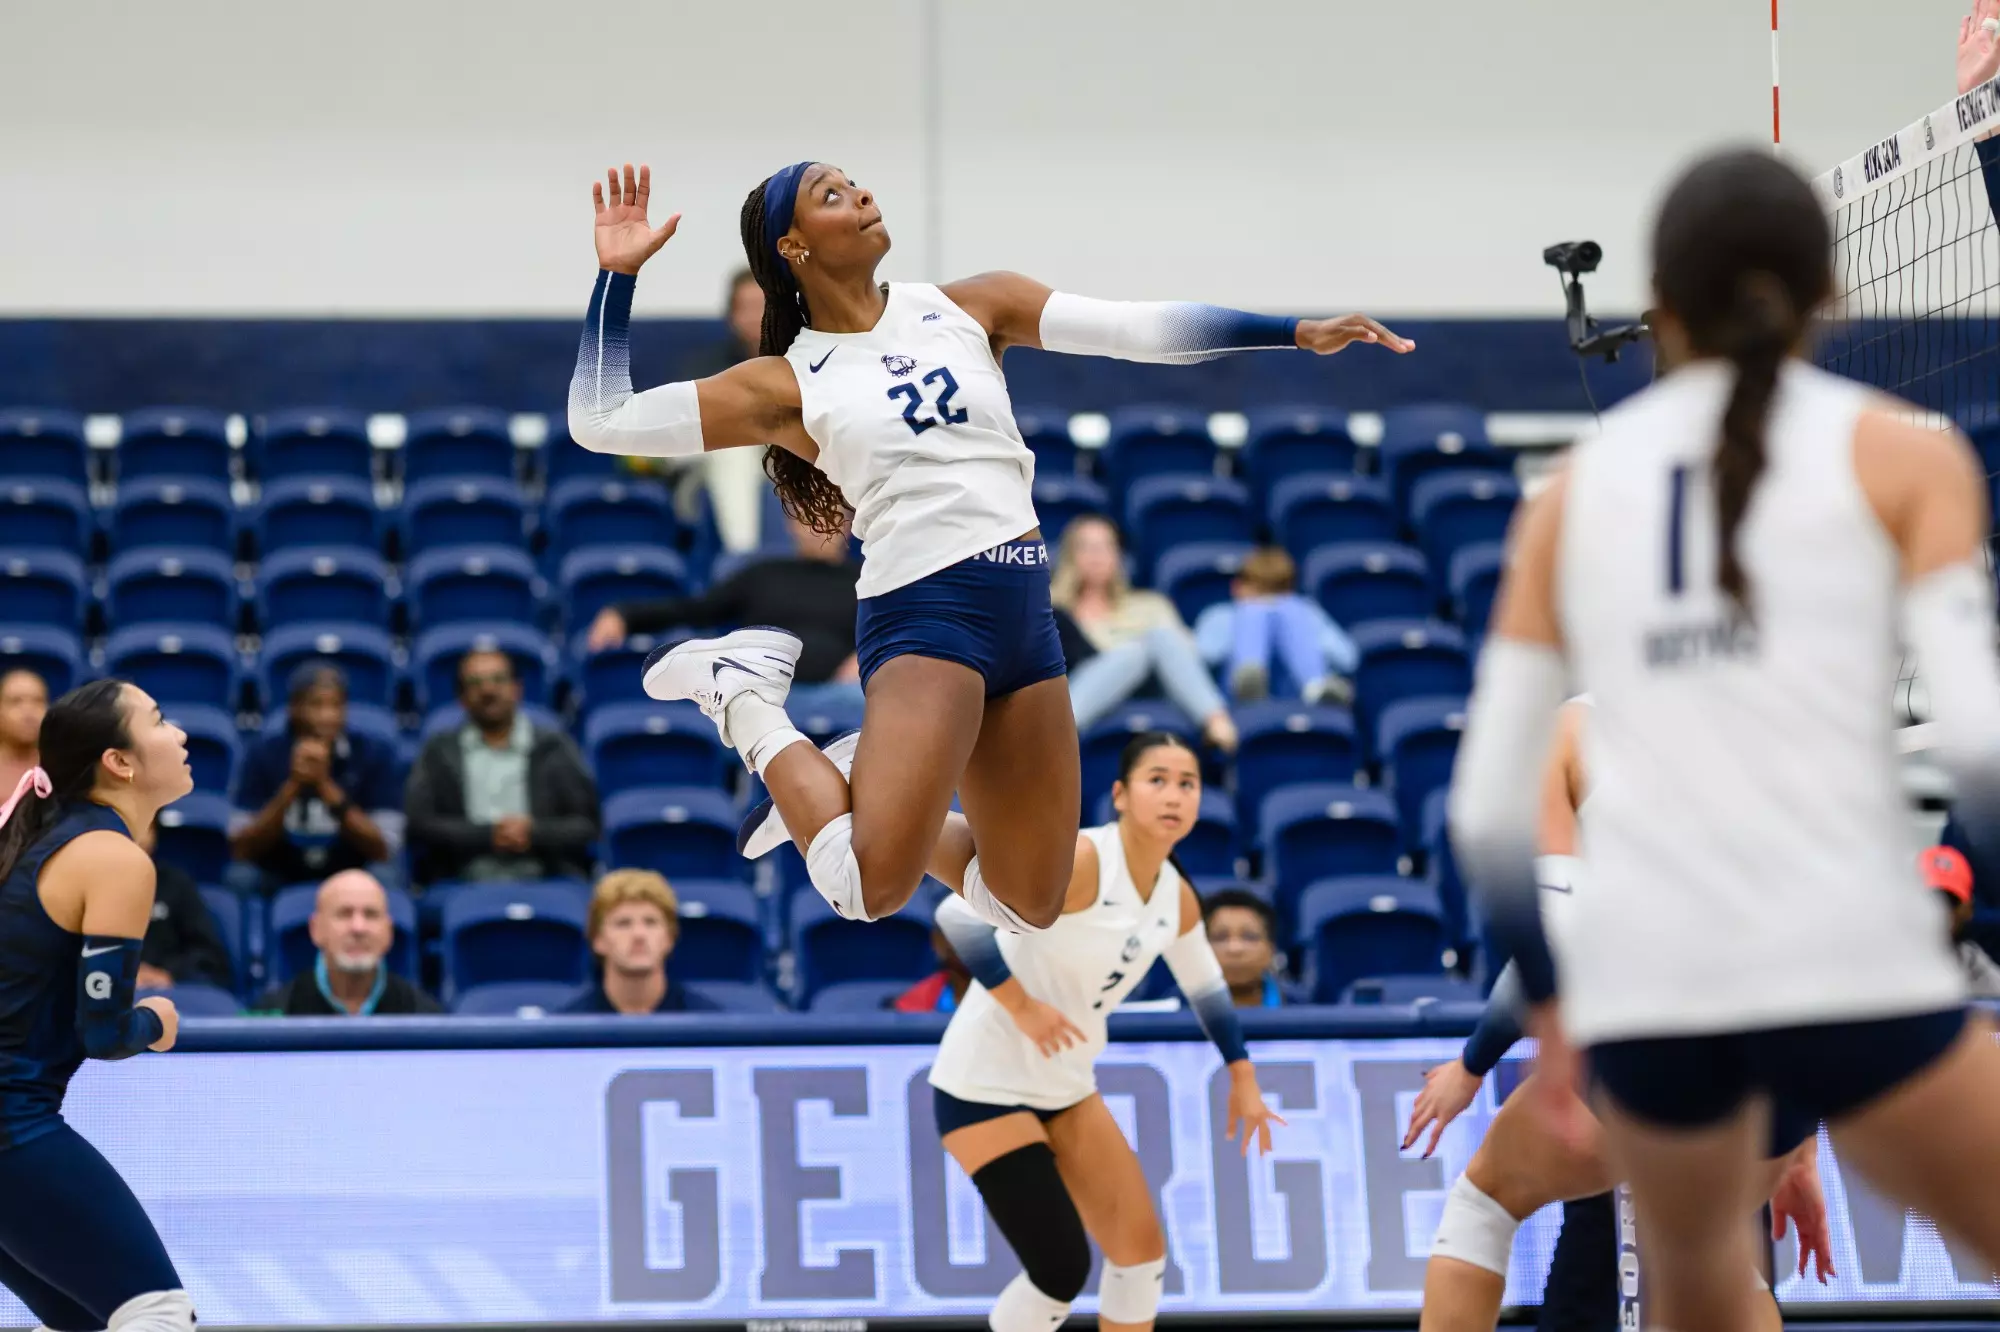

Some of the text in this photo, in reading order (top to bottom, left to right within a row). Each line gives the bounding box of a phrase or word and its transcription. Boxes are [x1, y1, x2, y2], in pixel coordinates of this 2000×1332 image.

[887, 366, 968, 436] 22
[973, 544, 1036, 565] NIKE
[85, 970, 112, 1000] G
